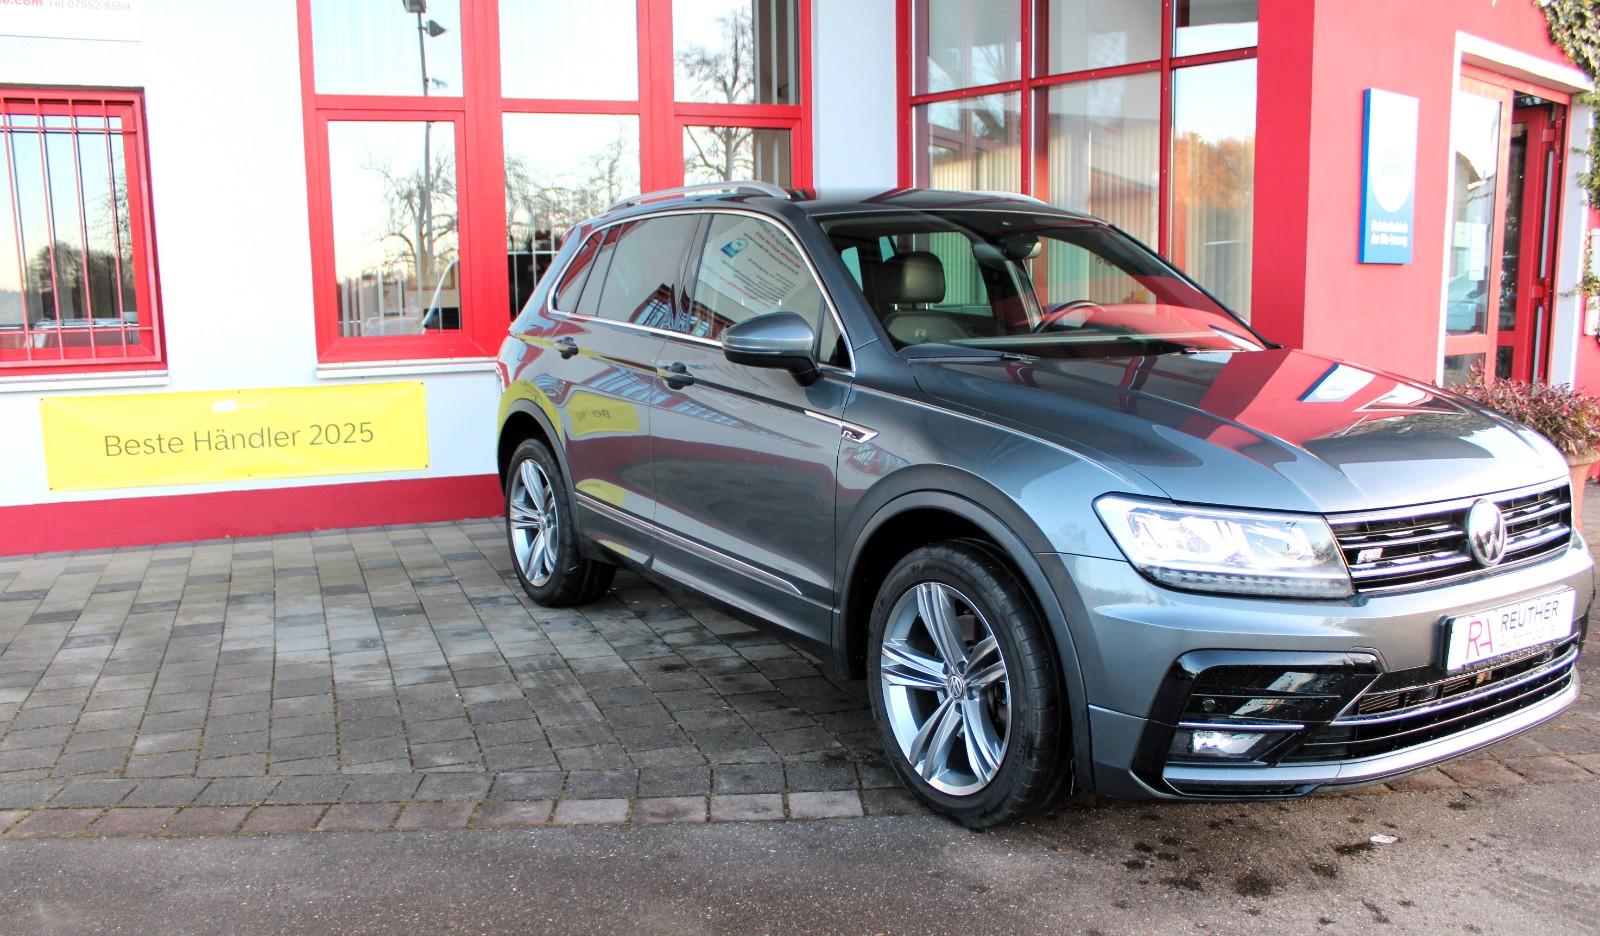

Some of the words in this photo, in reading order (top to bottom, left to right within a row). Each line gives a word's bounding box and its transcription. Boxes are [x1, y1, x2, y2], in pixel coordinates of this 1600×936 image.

[104, 434, 184, 457] Beste
[193, 426, 301, 452] Händler
[309, 422, 374, 445] 2025
[1500, 600, 1560, 633] REUTHER
